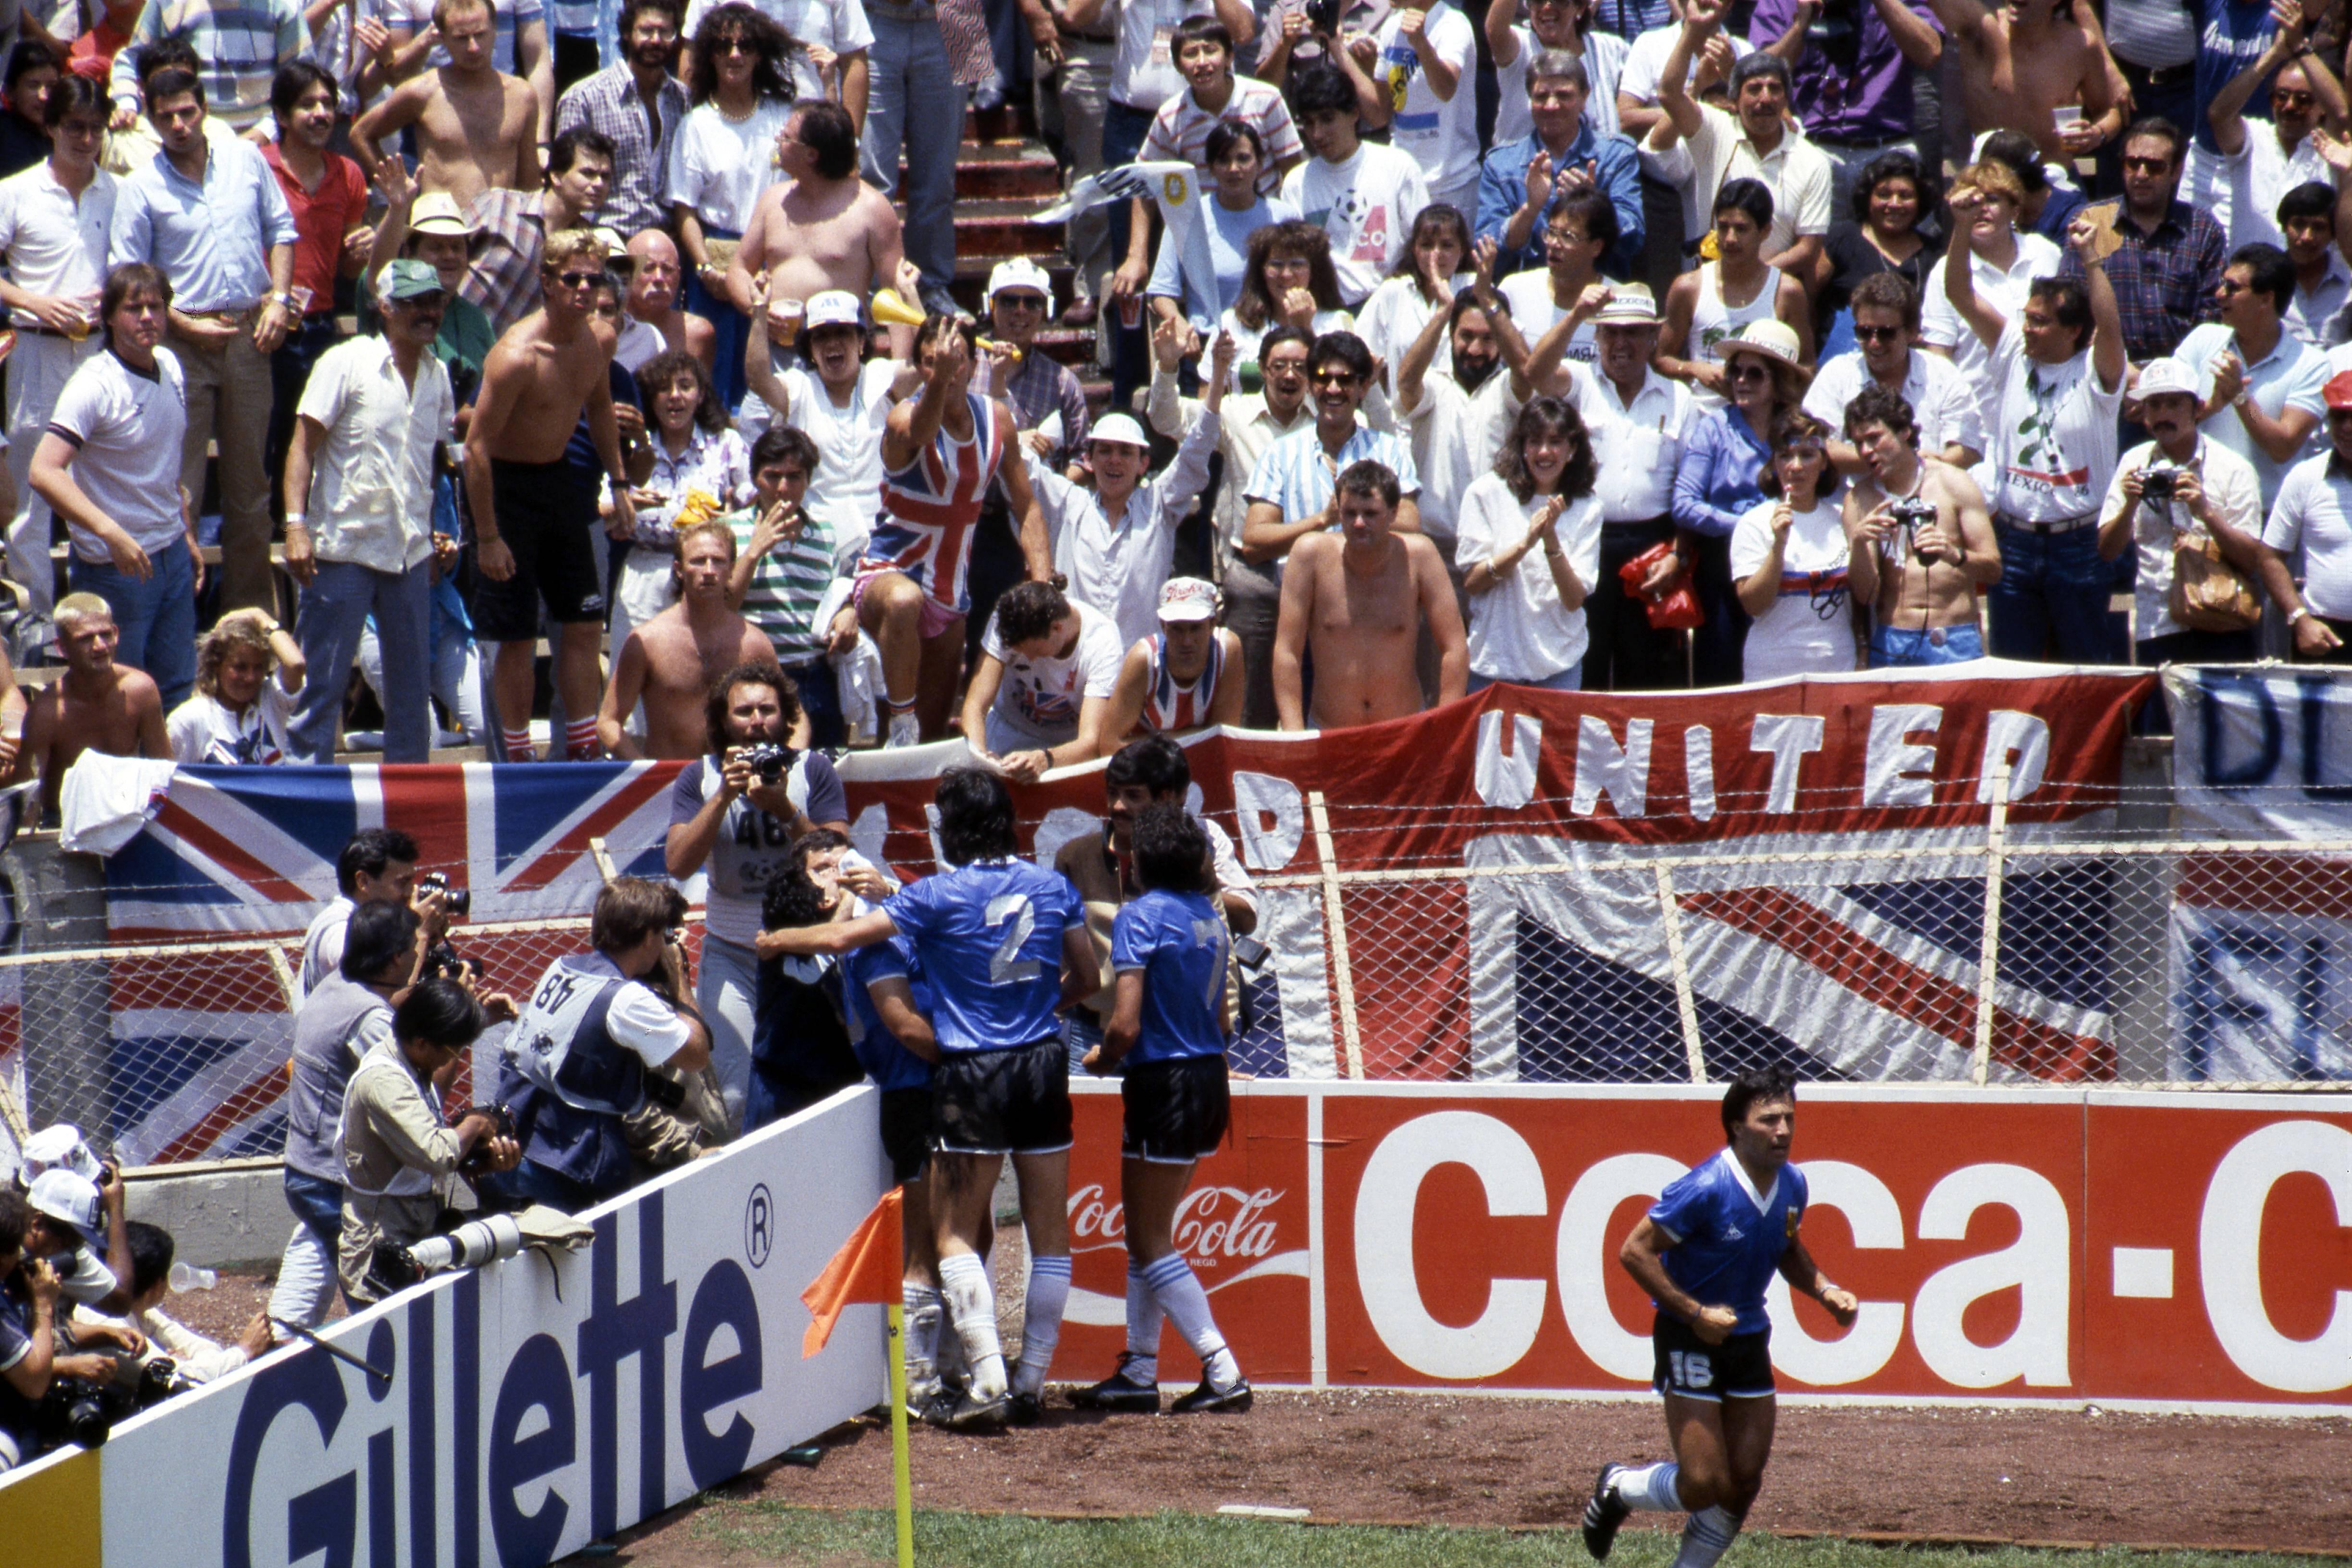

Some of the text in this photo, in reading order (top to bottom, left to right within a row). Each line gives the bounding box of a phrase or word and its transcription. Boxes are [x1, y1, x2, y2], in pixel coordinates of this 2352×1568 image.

[1475, 703, 2050, 821] UNITED
[985, 894, 1041, 987] 2
[1191, 918, 1228, 1009] 7
[1190, 1258, 1217, 1267] REGD
[222, 1188, 763, 1568] Gillette
[1669, 1351, 1714, 1388] 16
